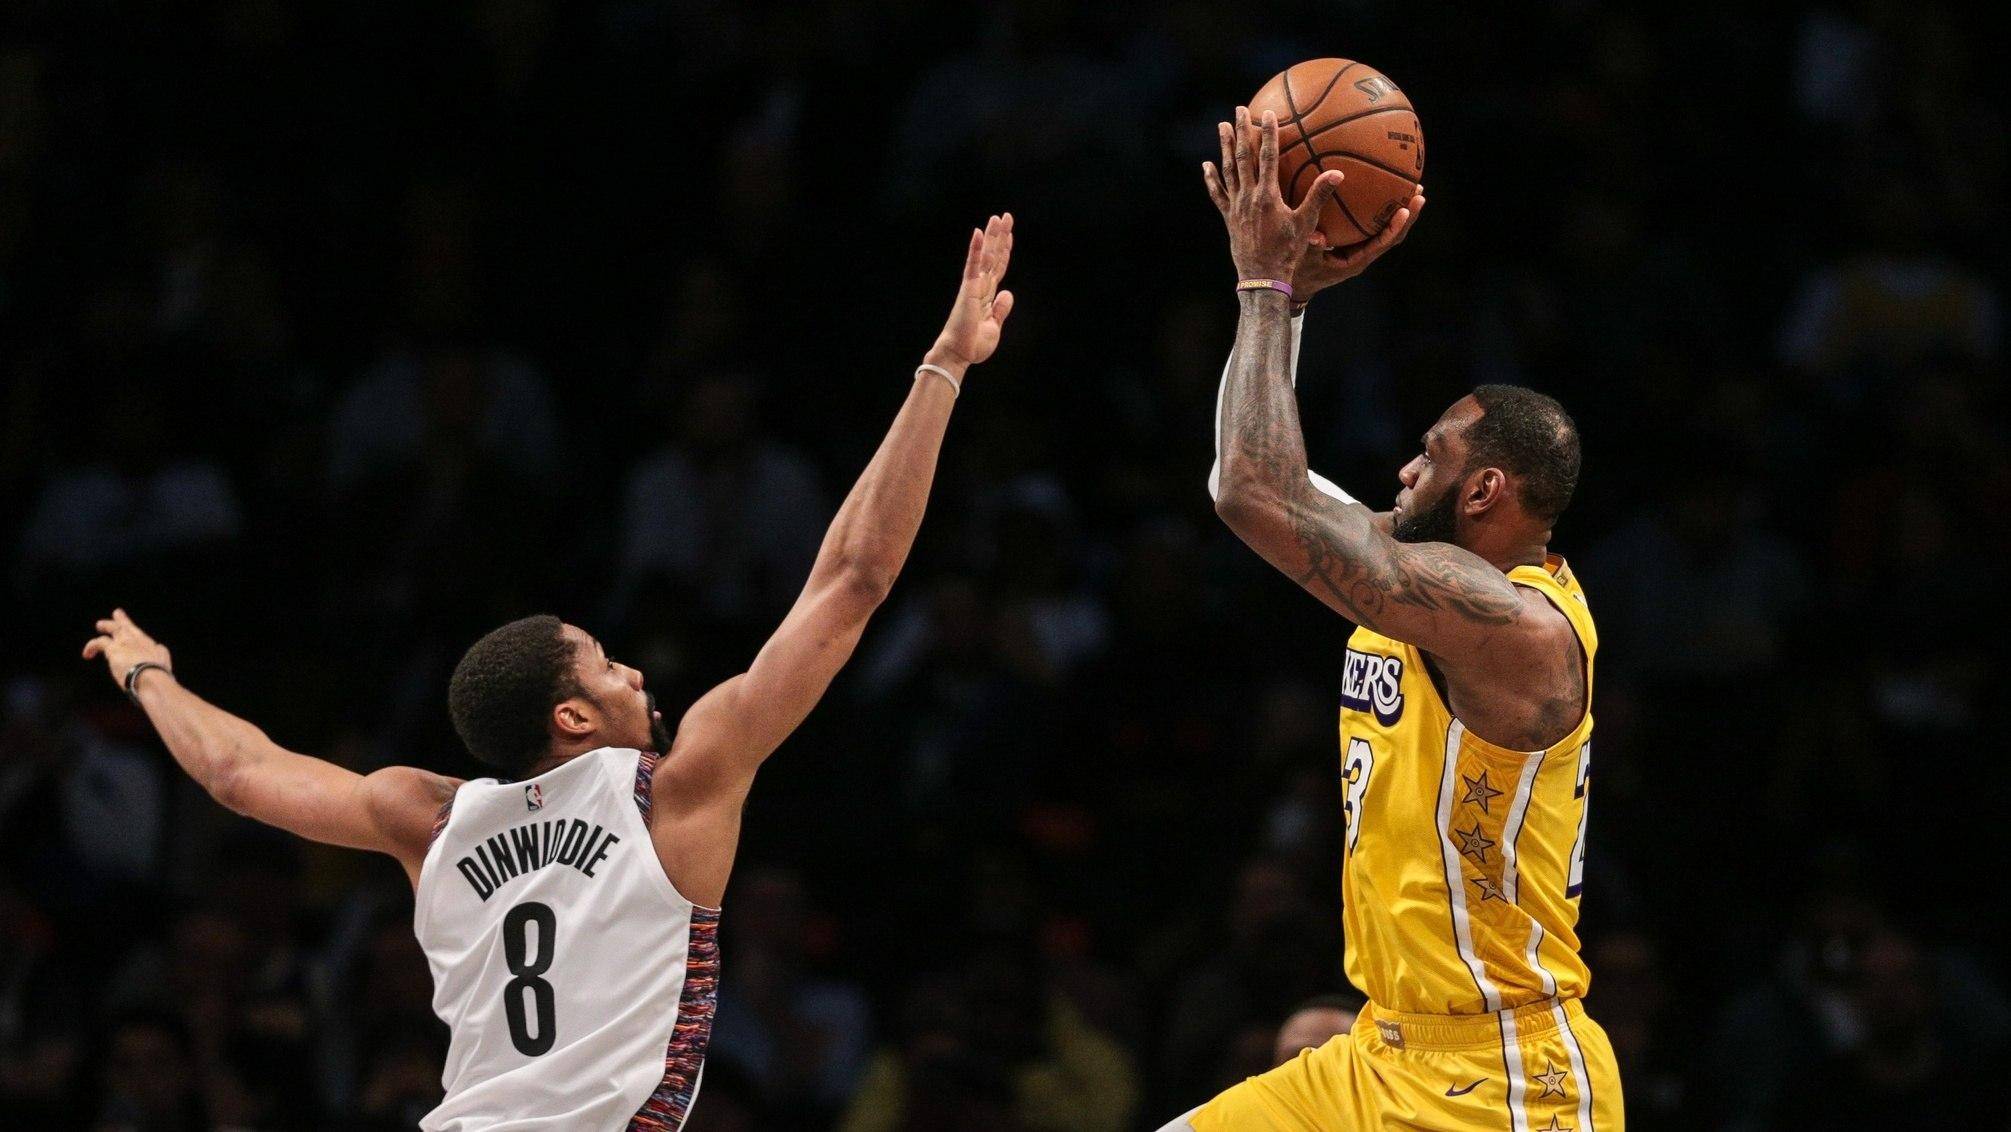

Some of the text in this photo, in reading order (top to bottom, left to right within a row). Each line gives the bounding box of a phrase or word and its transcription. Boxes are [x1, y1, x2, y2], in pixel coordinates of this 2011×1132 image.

[1241, 280, 1273, 289] PROMISE
[456, 818, 620, 902] DINWIDDIE
[503, 901, 556, 1057] 8
